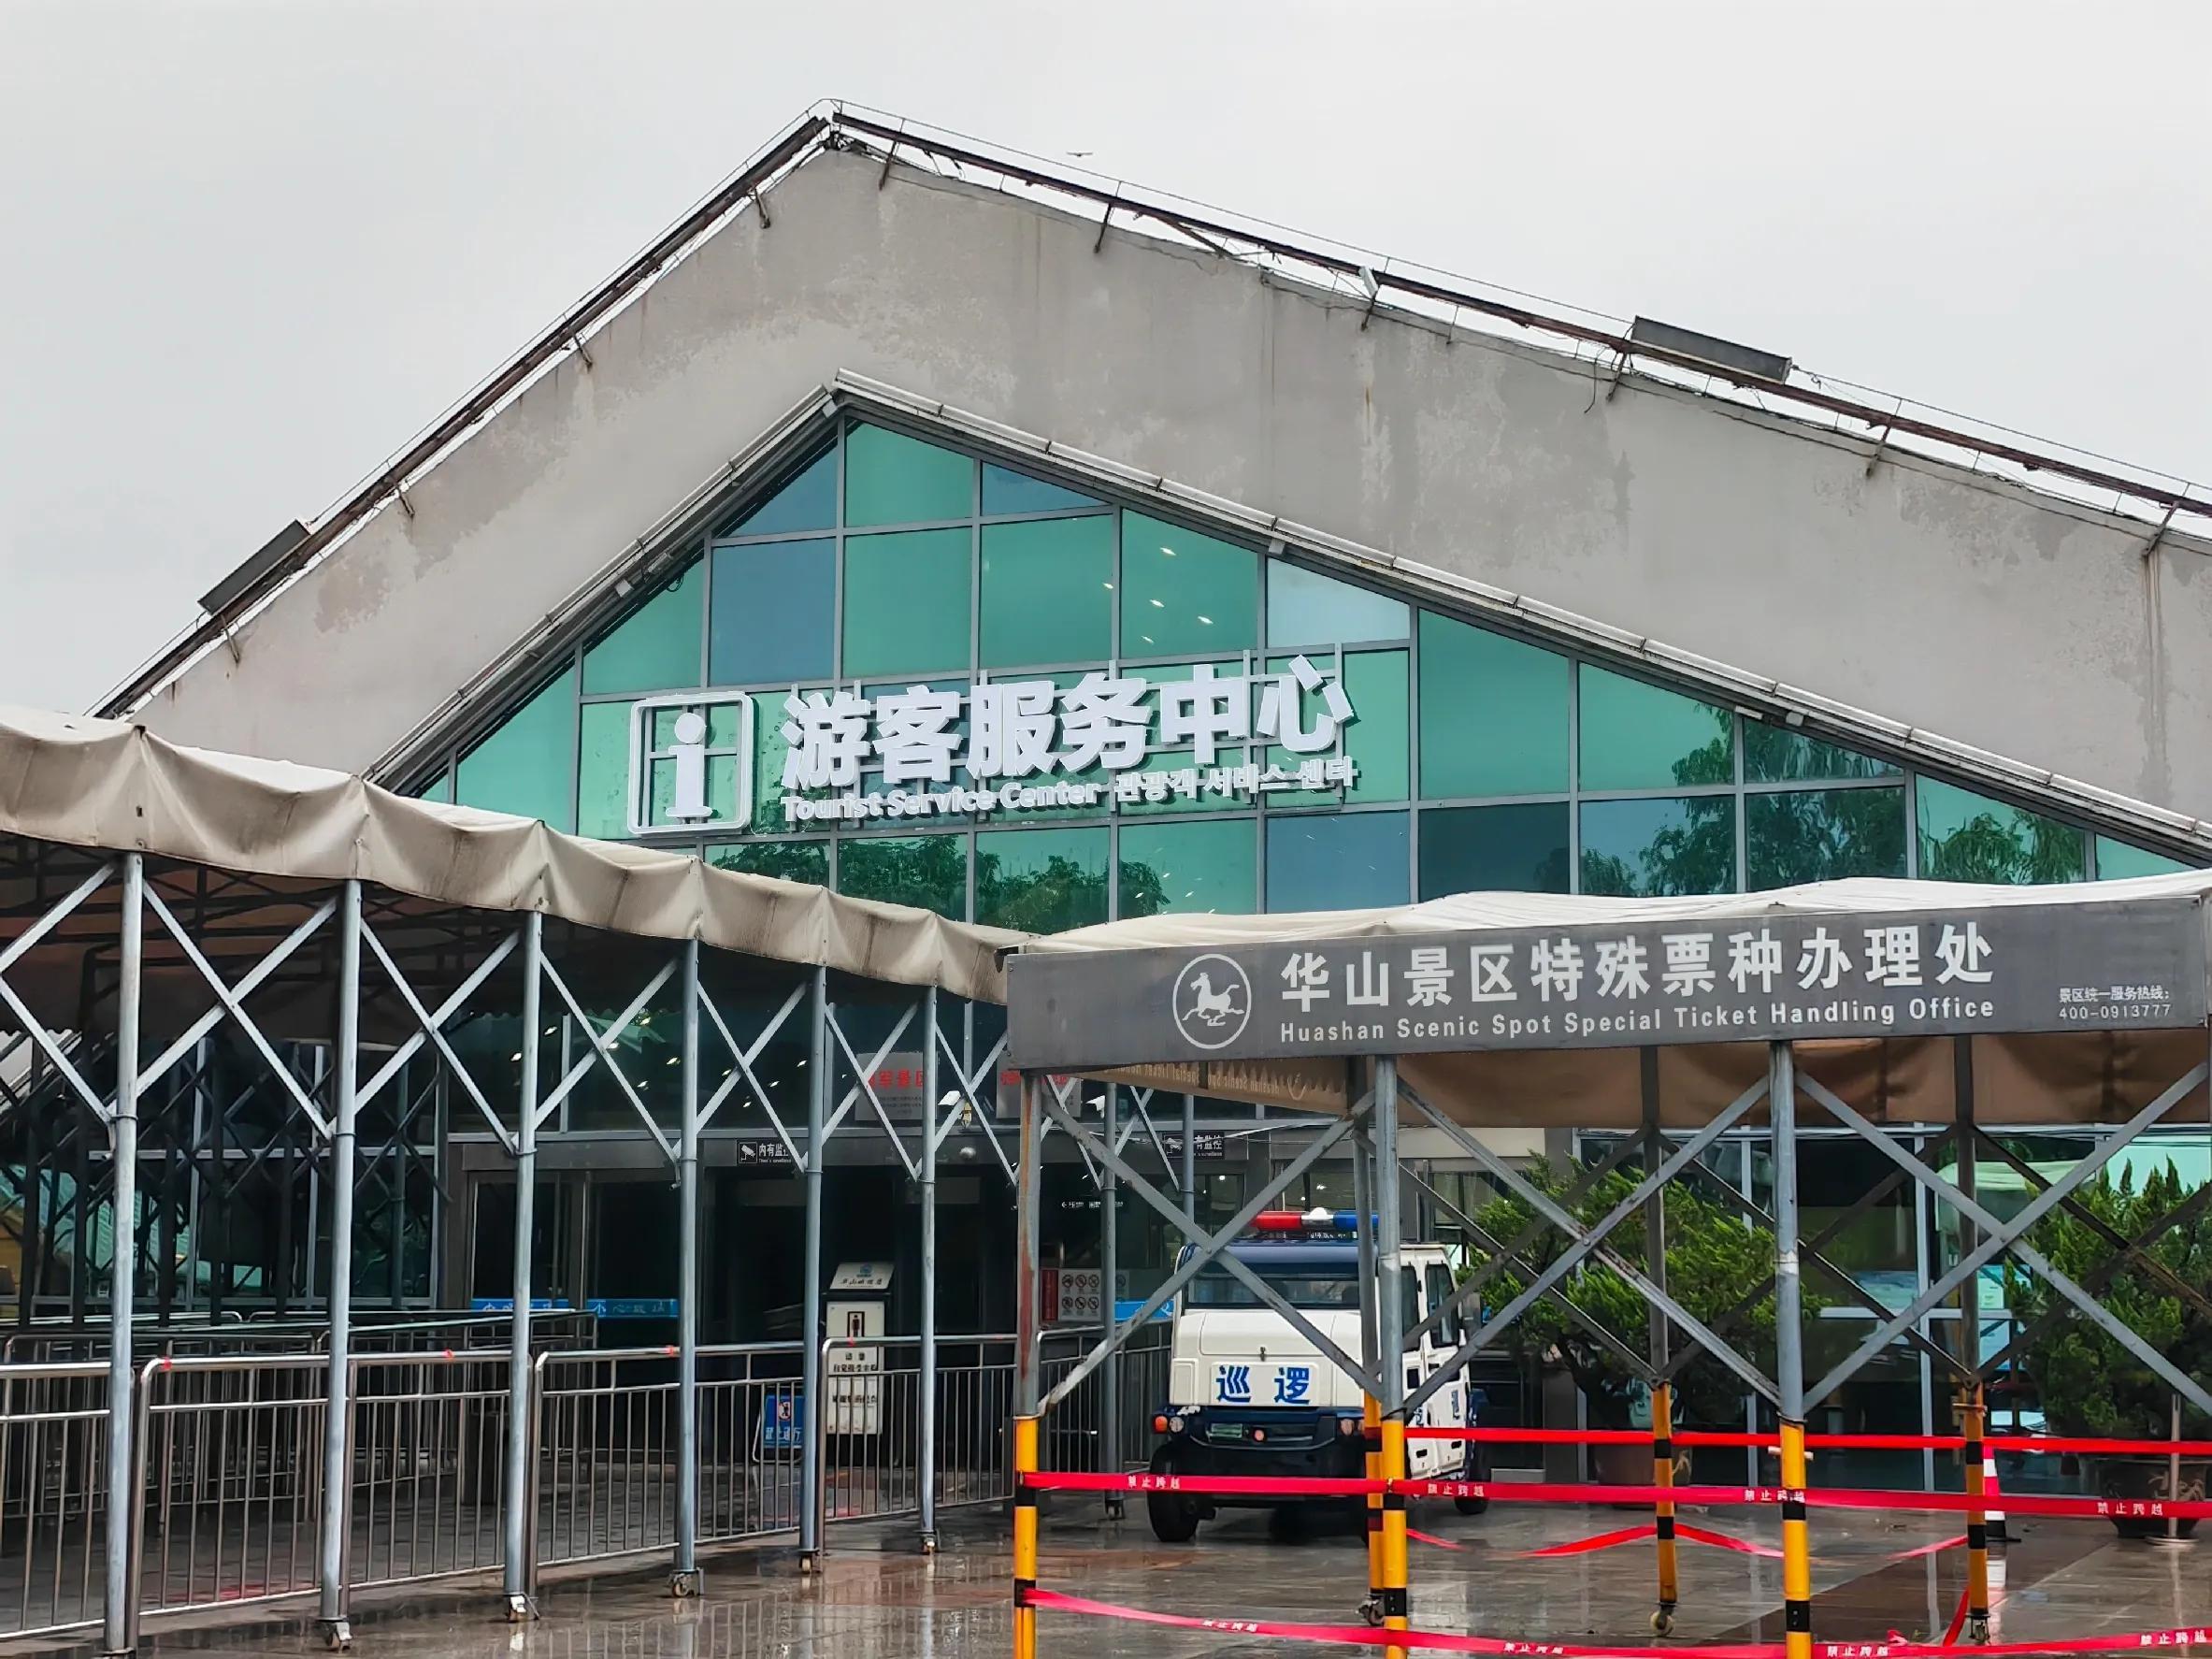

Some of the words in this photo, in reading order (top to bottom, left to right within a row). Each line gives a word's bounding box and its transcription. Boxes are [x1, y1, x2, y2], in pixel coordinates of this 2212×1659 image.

[781, 655, 1353, 790] 游客服务中心
[781, 793, 883, 822] Tourist
[887, 785, 995, 816] Service
[999, 779, 1101, 809] Center
[1114, 769, 1198, 802] 관광객
[1203, 763, 1289, 798] 서비스
[1300, 756, 1357, 790] 센터
[1281, 921, 1994, 1013] 华山景区特殊票种办理处
[1281, 1021, 1385, 1043] Huashan
[1397, 1015, 1480, 1038] Scenic
[1492, 1014, 1552, 1038] Spot
[1564, 1008, 1660, 1037] Special
[1674, 1005, 1758, 1028] Ticket
[1771, 1000, 1895, 1025] Handling
[1909, 997, 1994, 1020] Office
[2059, 1004, 2171, 1019] 400-0913777
[1216, 1364, 1311, 1403] 巡逻
[2097, 1502, 2162, 1516] 禁止跨越
